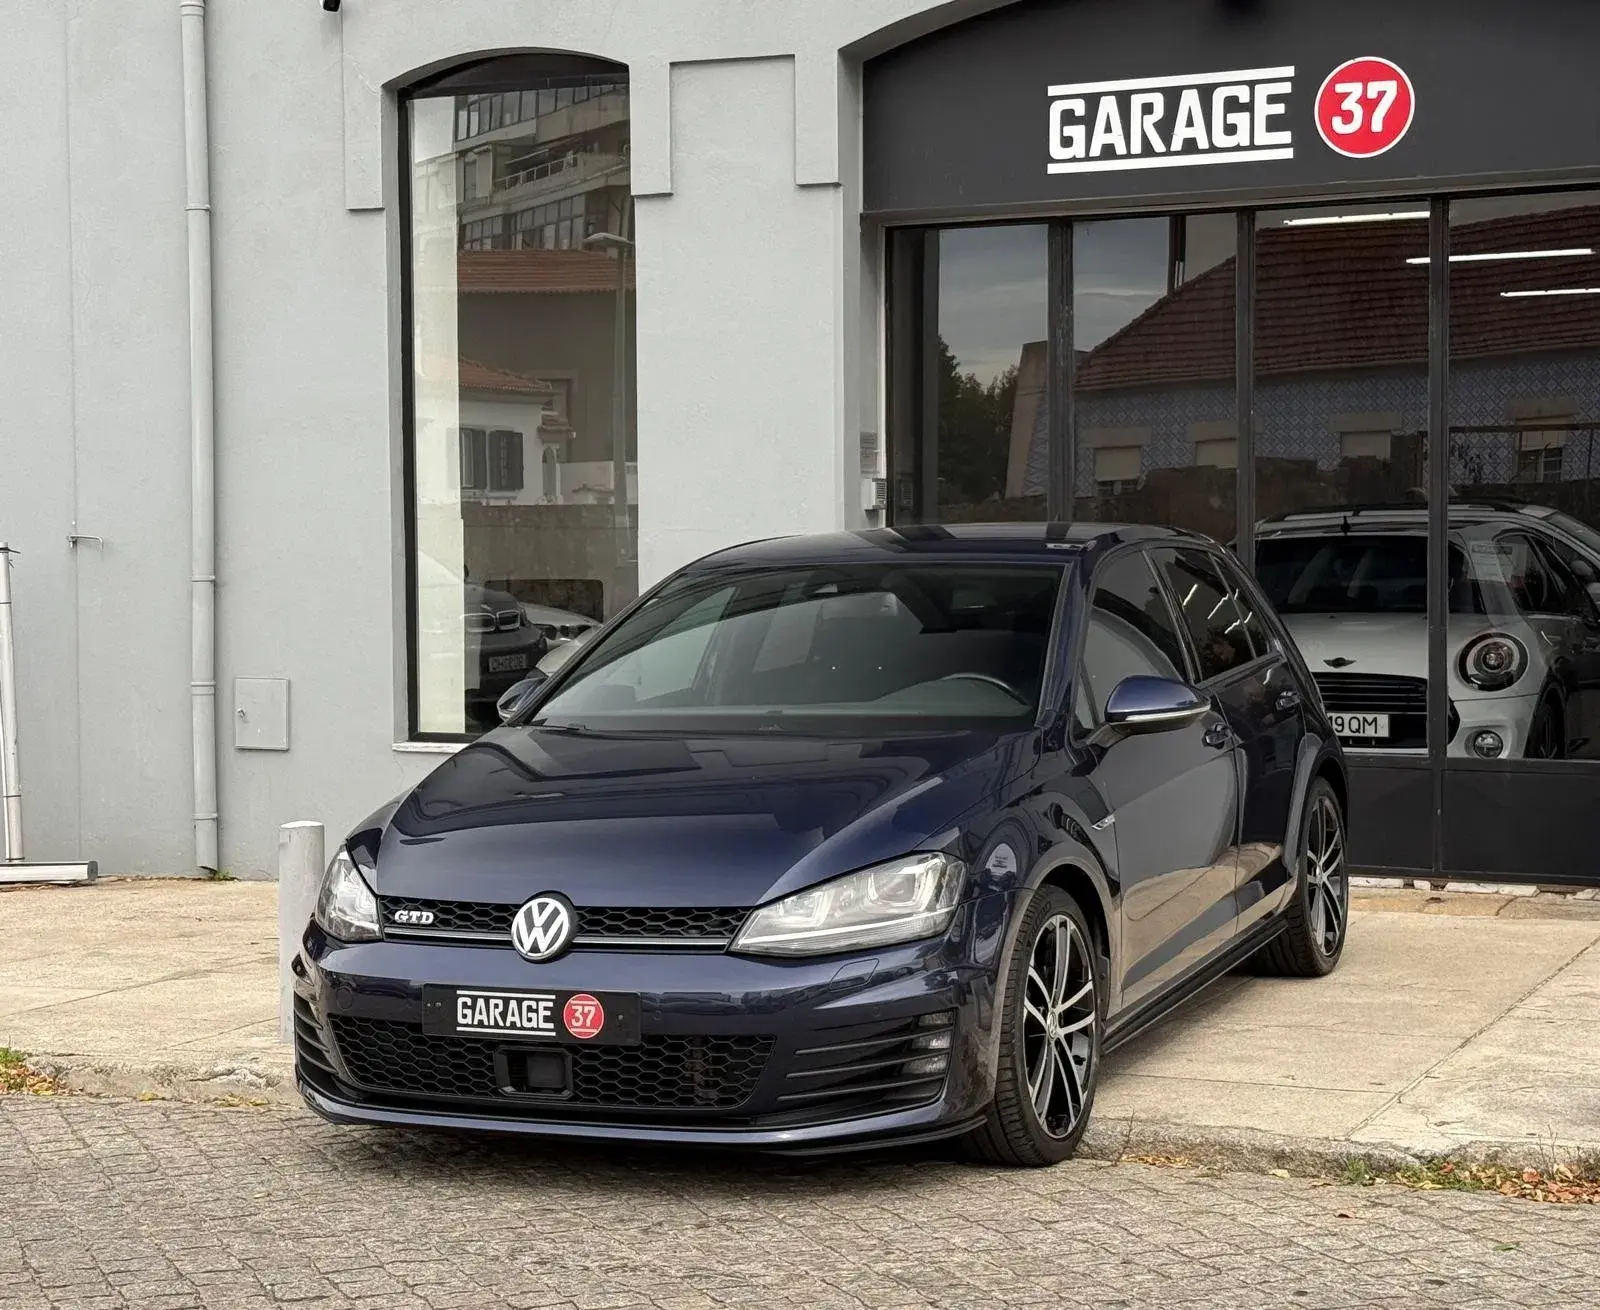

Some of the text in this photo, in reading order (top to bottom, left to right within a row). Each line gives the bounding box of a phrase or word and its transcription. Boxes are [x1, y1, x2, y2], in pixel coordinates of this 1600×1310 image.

[1049, 80, 1397, 160] GARAGE 37
[394, 910, 434, 925] GTD
[512, 897, 569, 959] VW
[456, 996, 596, 1028] GARAGE 37
